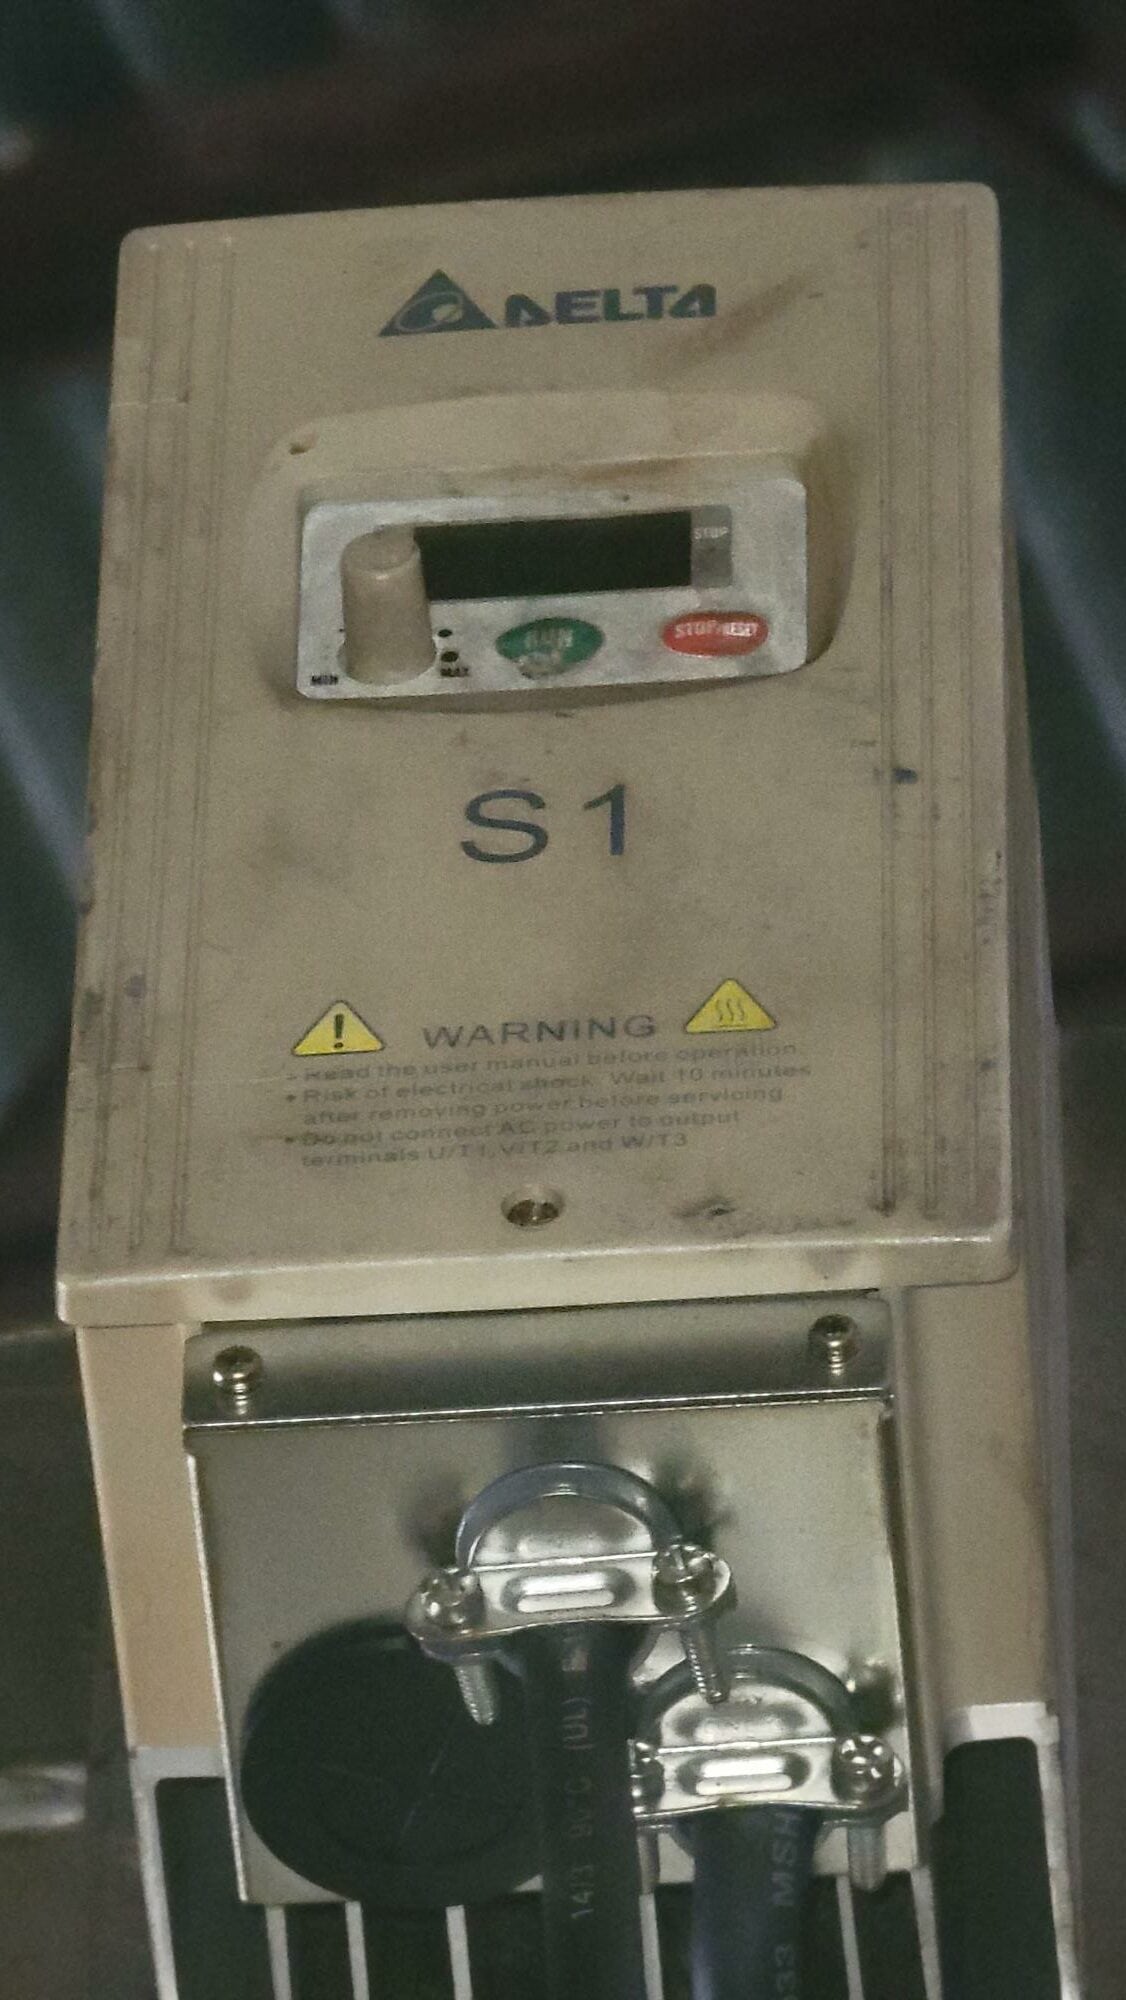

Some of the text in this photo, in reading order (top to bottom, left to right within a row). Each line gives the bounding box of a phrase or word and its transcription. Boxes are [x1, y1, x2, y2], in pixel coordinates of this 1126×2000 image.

[504, 283, 717, 328] DELTA
[311, 674, 339, 686] MIN
[440, 665, 470, 678] MAX
[422, 1015, 655, 1048] WARNING
[303, 1043, 797, 1081] Read the user manual before operation
[303, 1088, 356, 1103] Risk
[365, 1086, 388, 1100] of
[396, 1077, 512, 1099] electrical
[608, 1071, 664, 1088] Wait
[677, 1067, 704, 1083] 10
[711, 1062, 811, 1080] minutes
[303, 1086, 784, 1127] after removing power before servicing
[302, 1109, 739, 1146] Do not connect AC power to output
[302, 1151, 420, 1169] terminals
[567, 1136, 614, 1153] and
[621, 1130, 688, 1148] W/T3
[561, 1696, 594, 1752] (UL)
